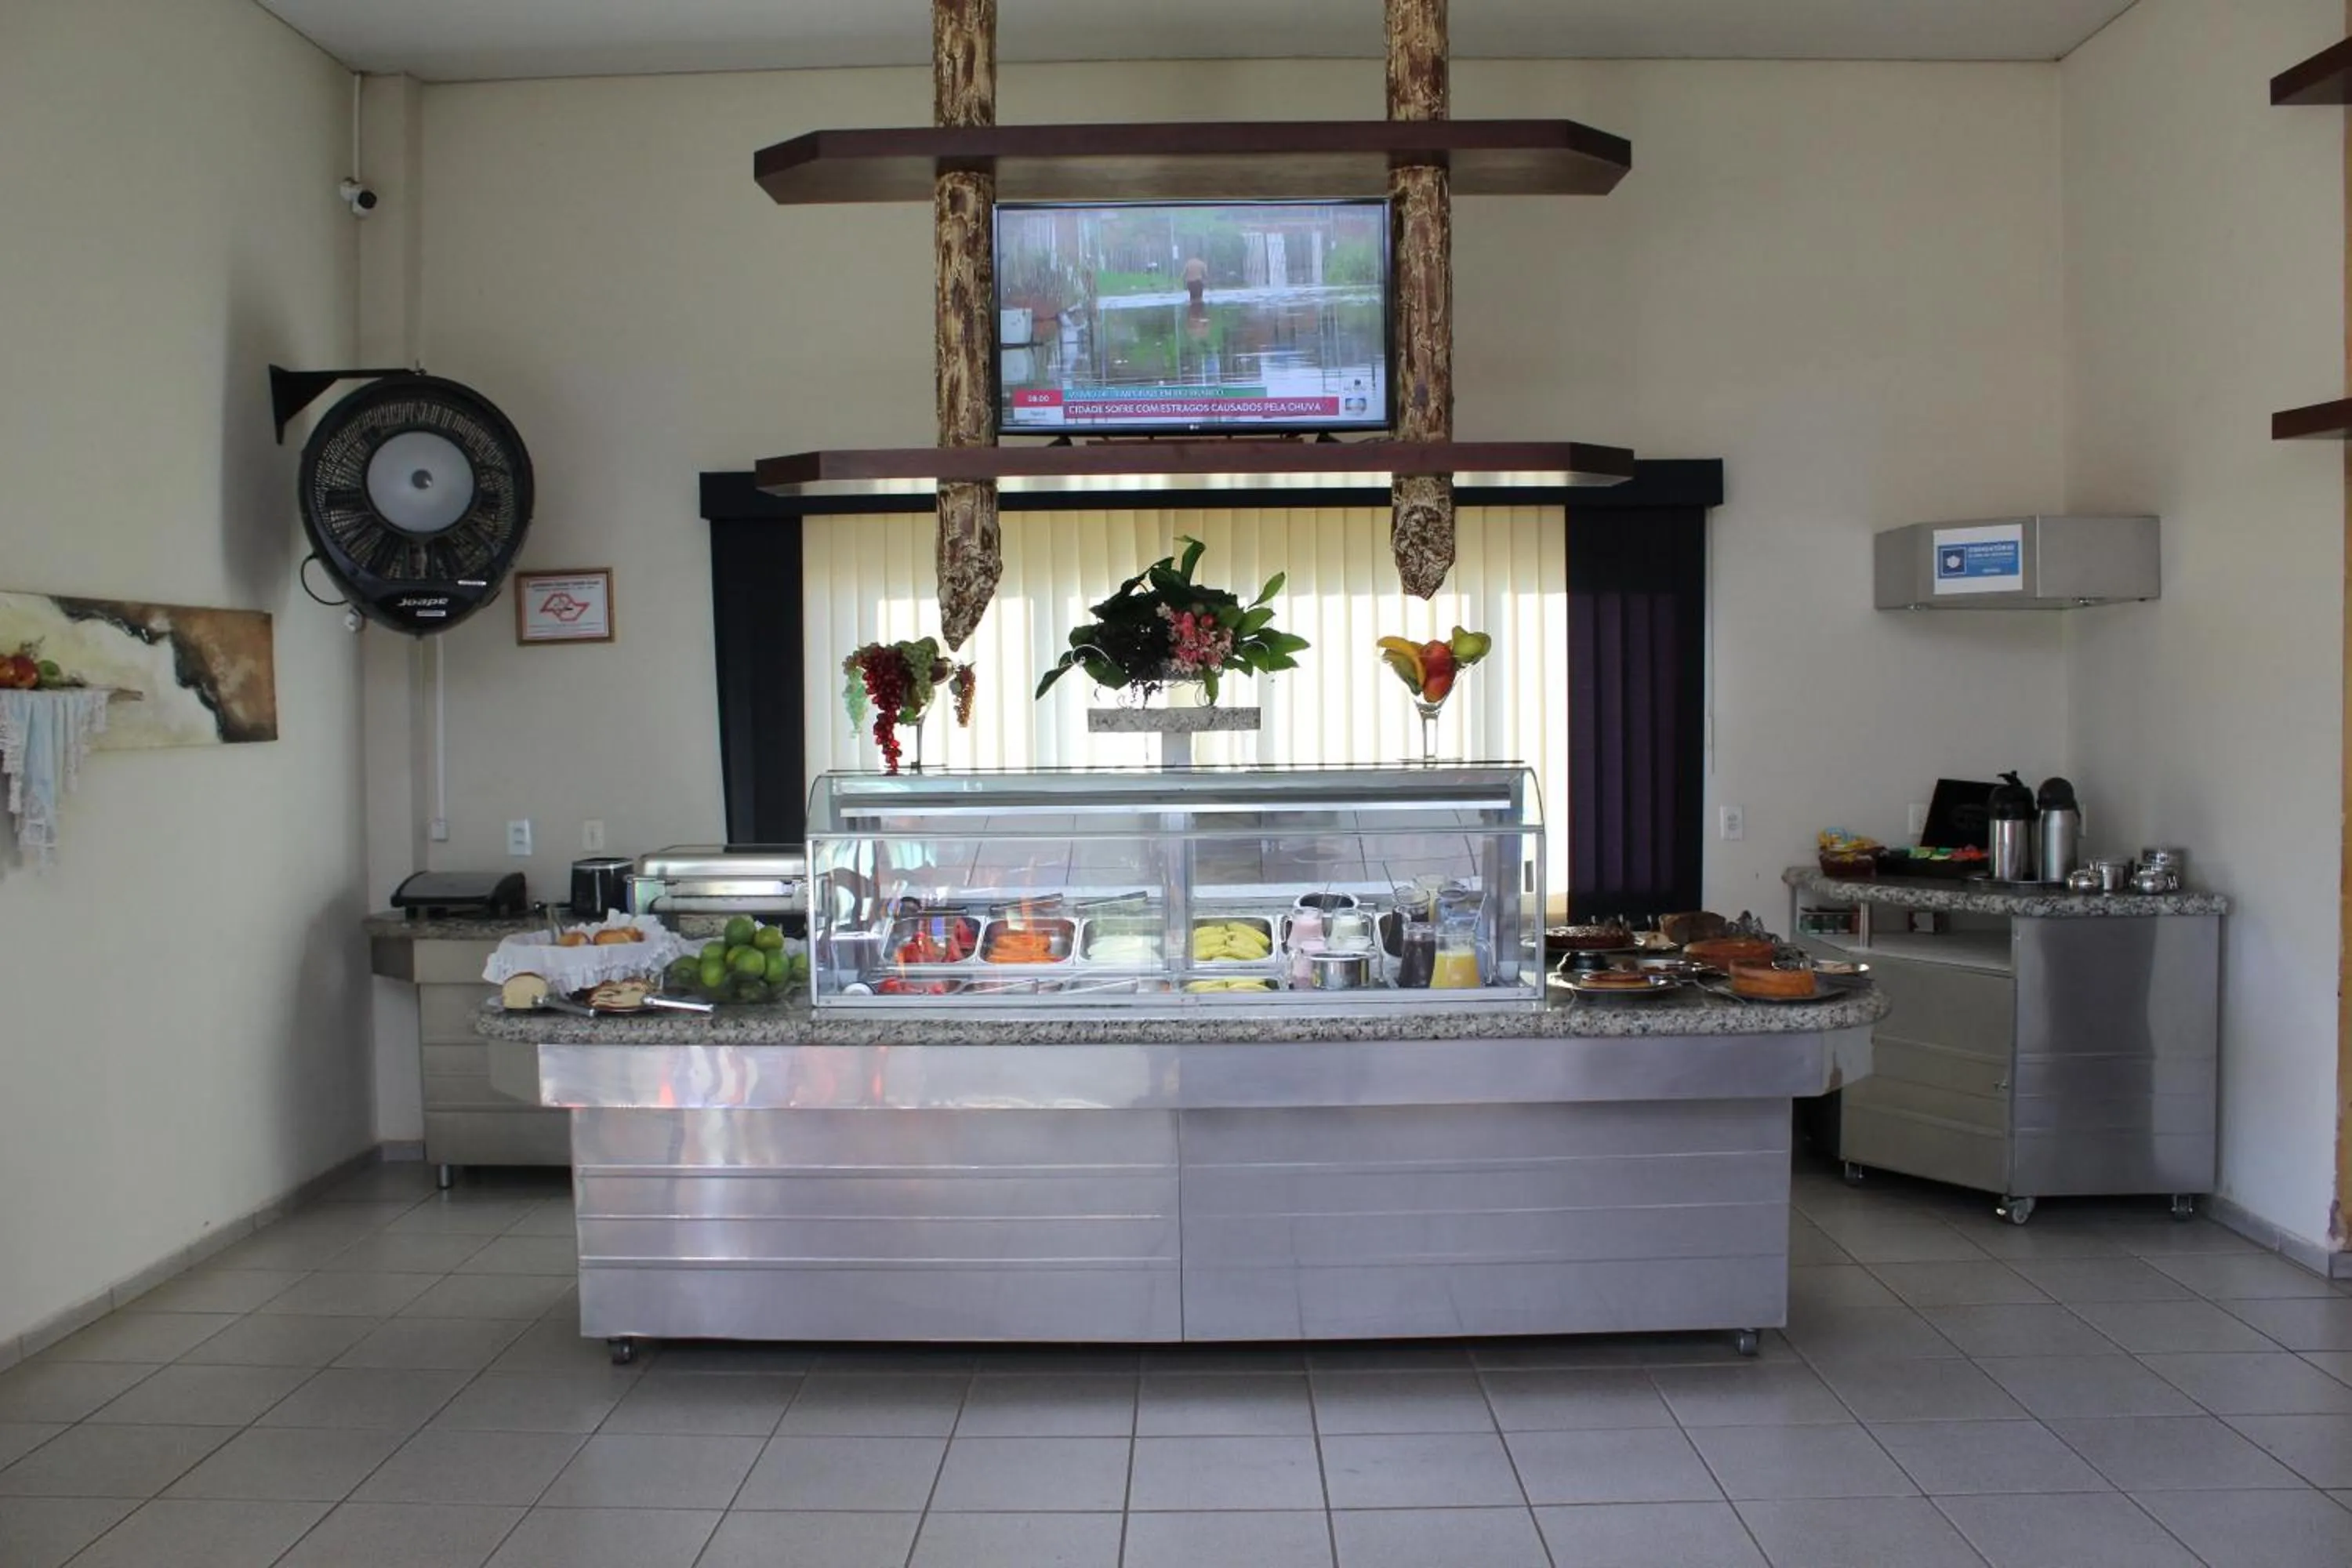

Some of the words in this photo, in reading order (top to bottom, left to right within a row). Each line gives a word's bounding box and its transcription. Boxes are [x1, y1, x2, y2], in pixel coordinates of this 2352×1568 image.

[1069, 405, 1102, 414] CIDADE
[1105, 404, 1134, 413] SOFRE
[1136, 404, 1158, 413] COM
[1160, 403, 1209, 413] ESTRAGOS
[1210, 402, 1261, 412] CAUSADOS
[1264, 402, 1287, 412] PELA
[1287, 401, 1321, 412] CHUVA
